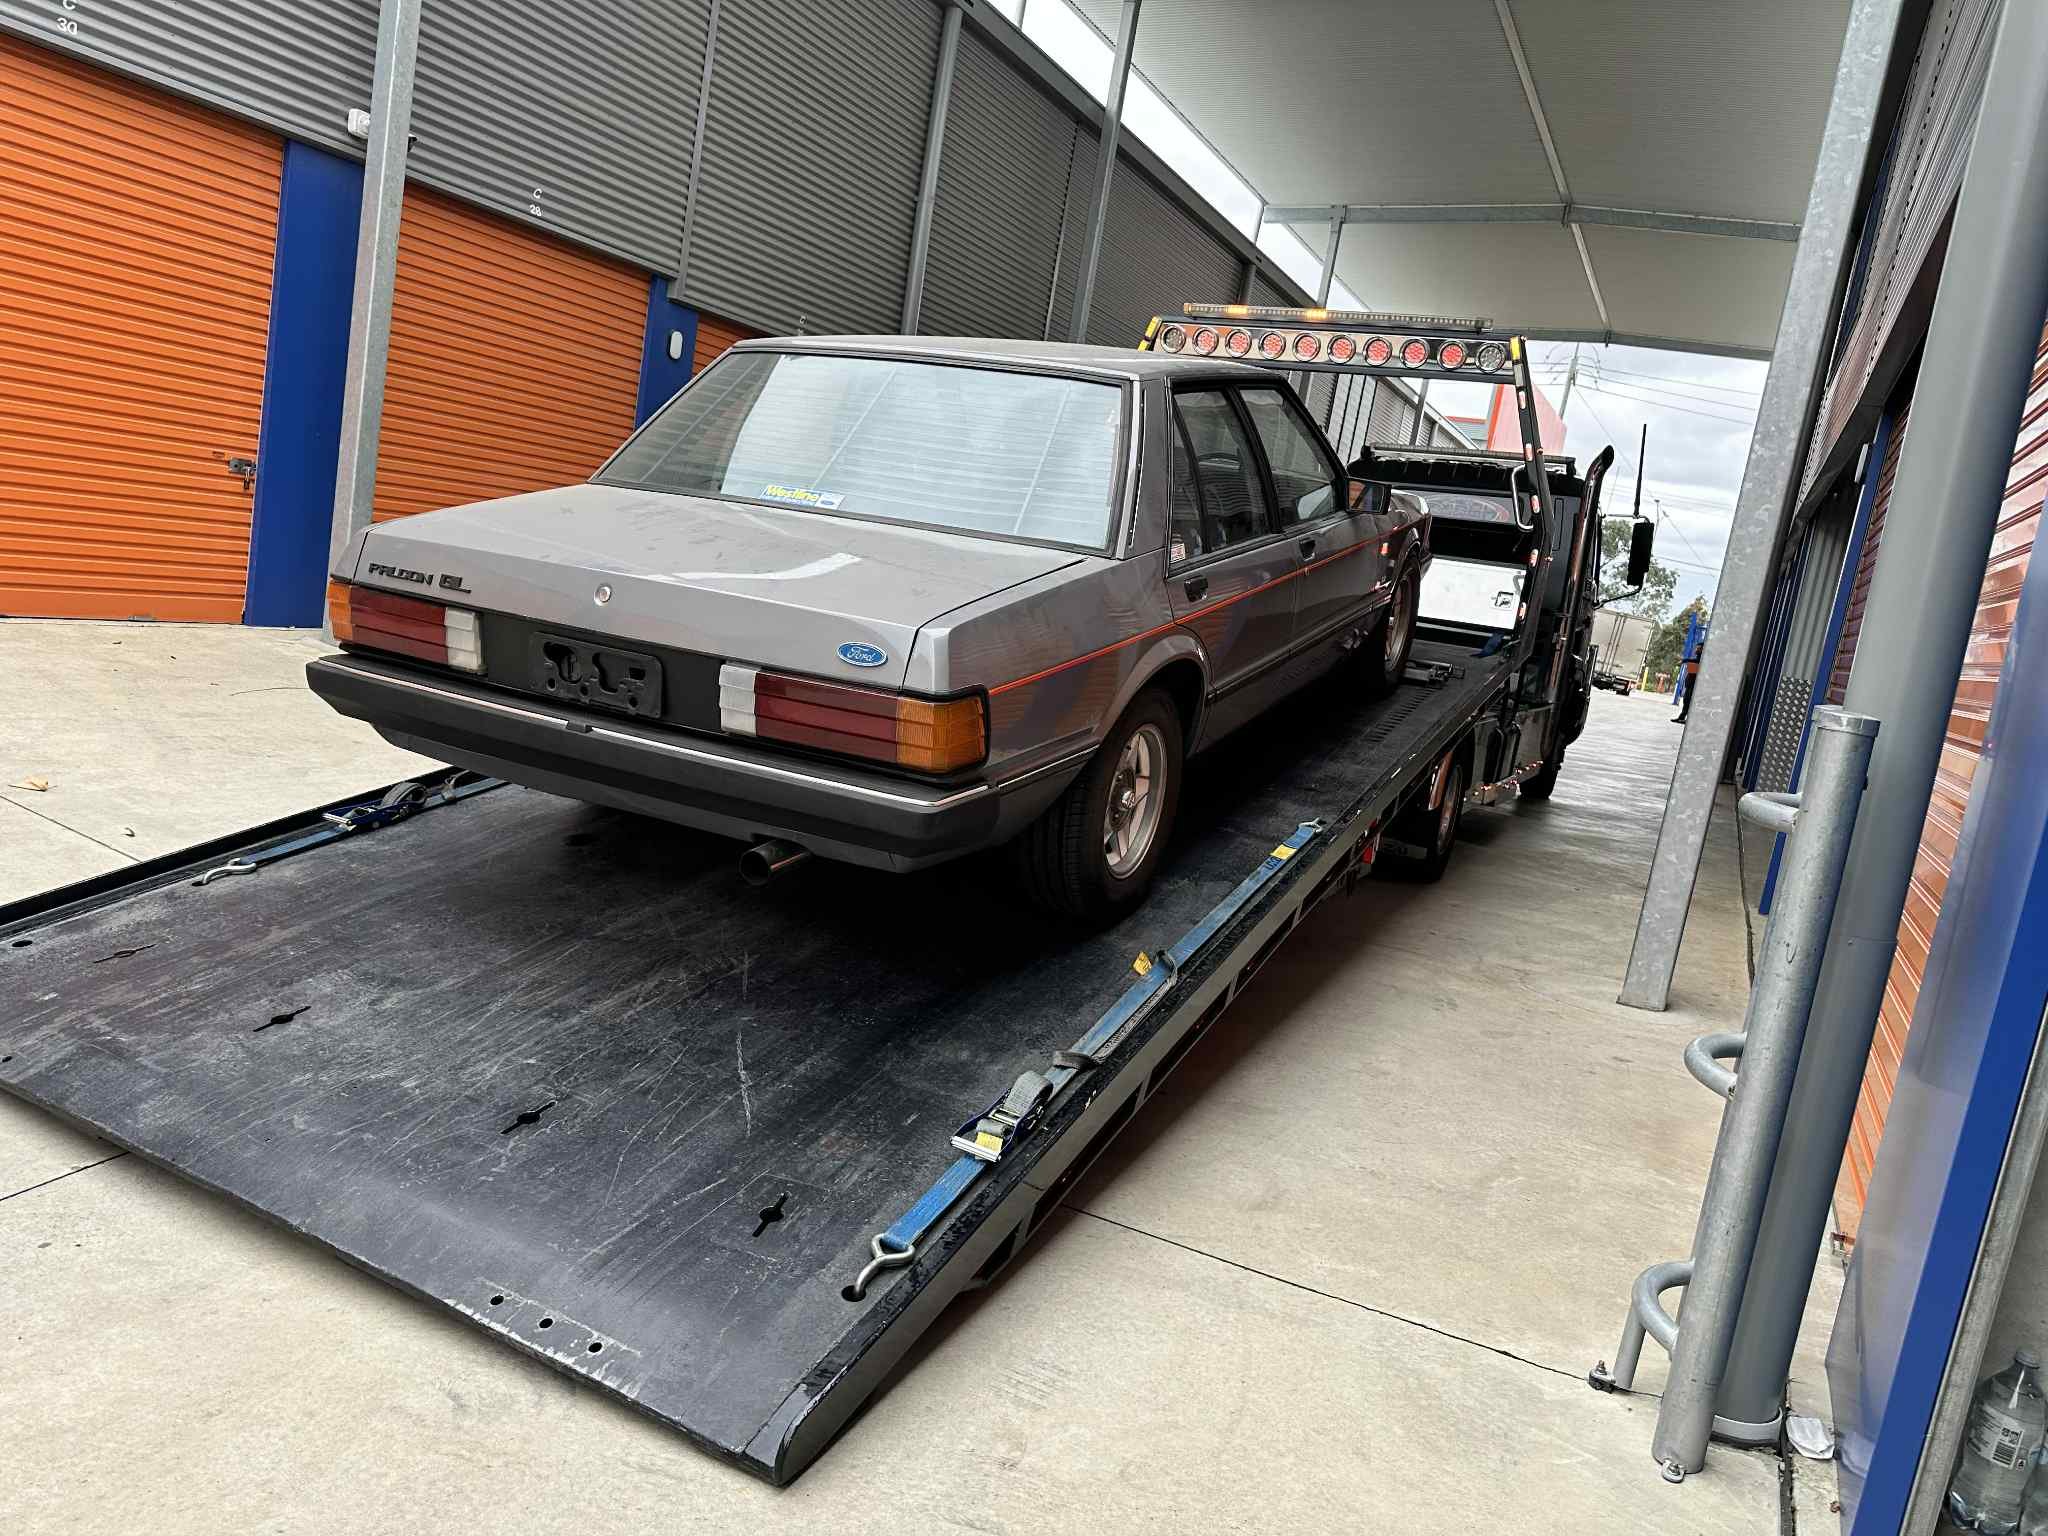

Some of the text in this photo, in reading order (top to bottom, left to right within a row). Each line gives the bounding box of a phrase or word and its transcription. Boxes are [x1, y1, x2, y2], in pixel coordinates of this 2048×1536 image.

[57, 17, 78, 35] 30
[533, 188, 543, 199] C
[529, 204, 542, 217] 28
[847, 646, 877, 662] Ford
